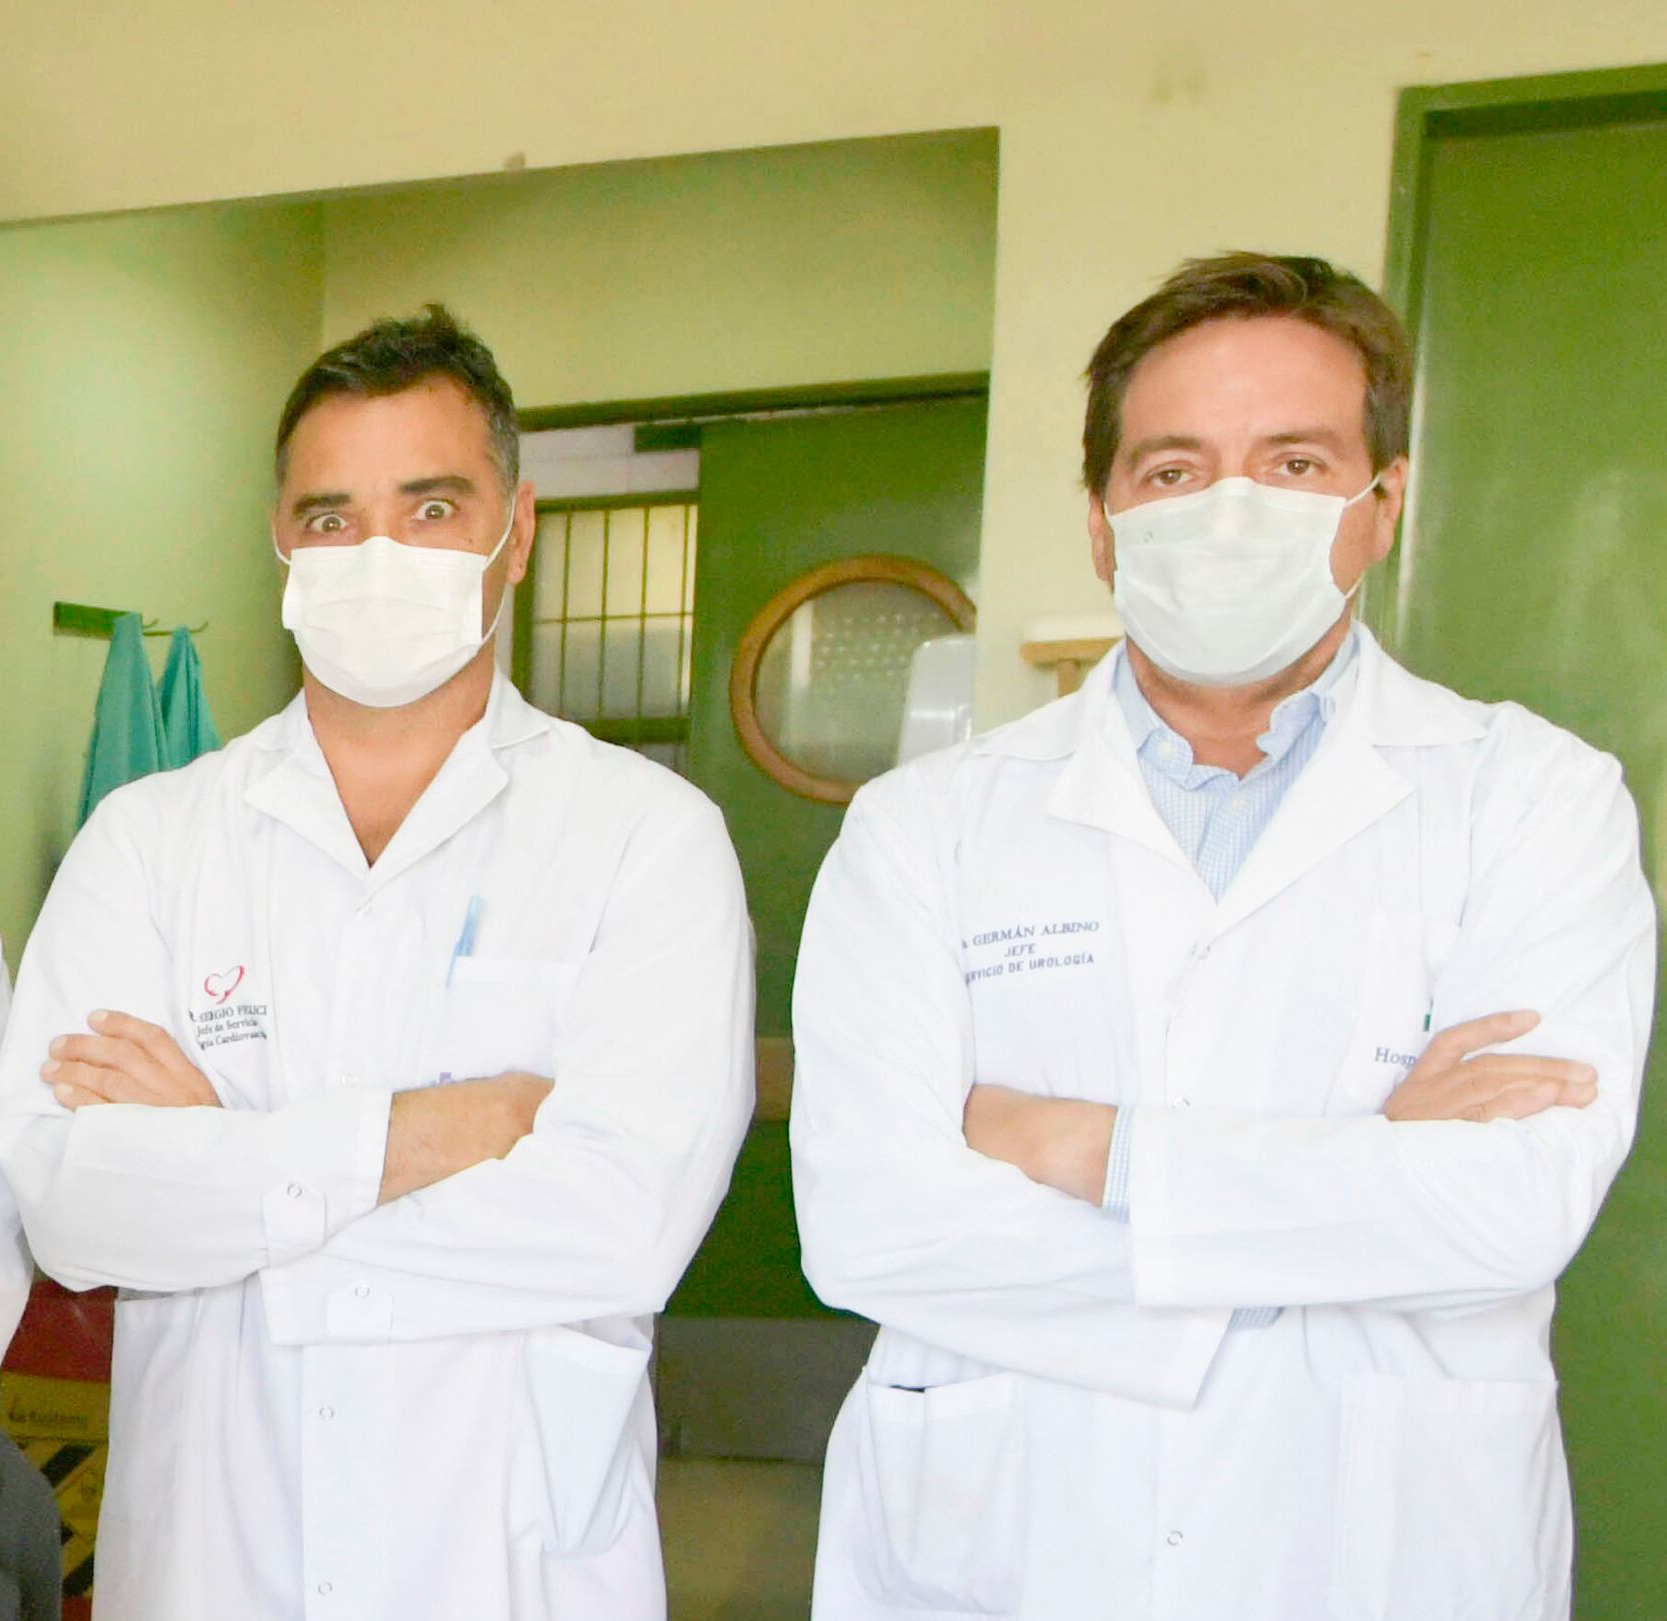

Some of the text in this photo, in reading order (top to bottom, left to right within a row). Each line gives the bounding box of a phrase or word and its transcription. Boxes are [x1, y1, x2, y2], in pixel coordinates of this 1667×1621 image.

[972, 924, 1036, 947] GERMÁN
[1041, 920, 1100, 936] ALBINO
[1004, 943, 1036, 957] JEFE
[1008, 960, 1025, 973] DE
[1029, 953, 1095, 970] UROLOGÍA
[199, 1006, 235, 1022] SERGIO
